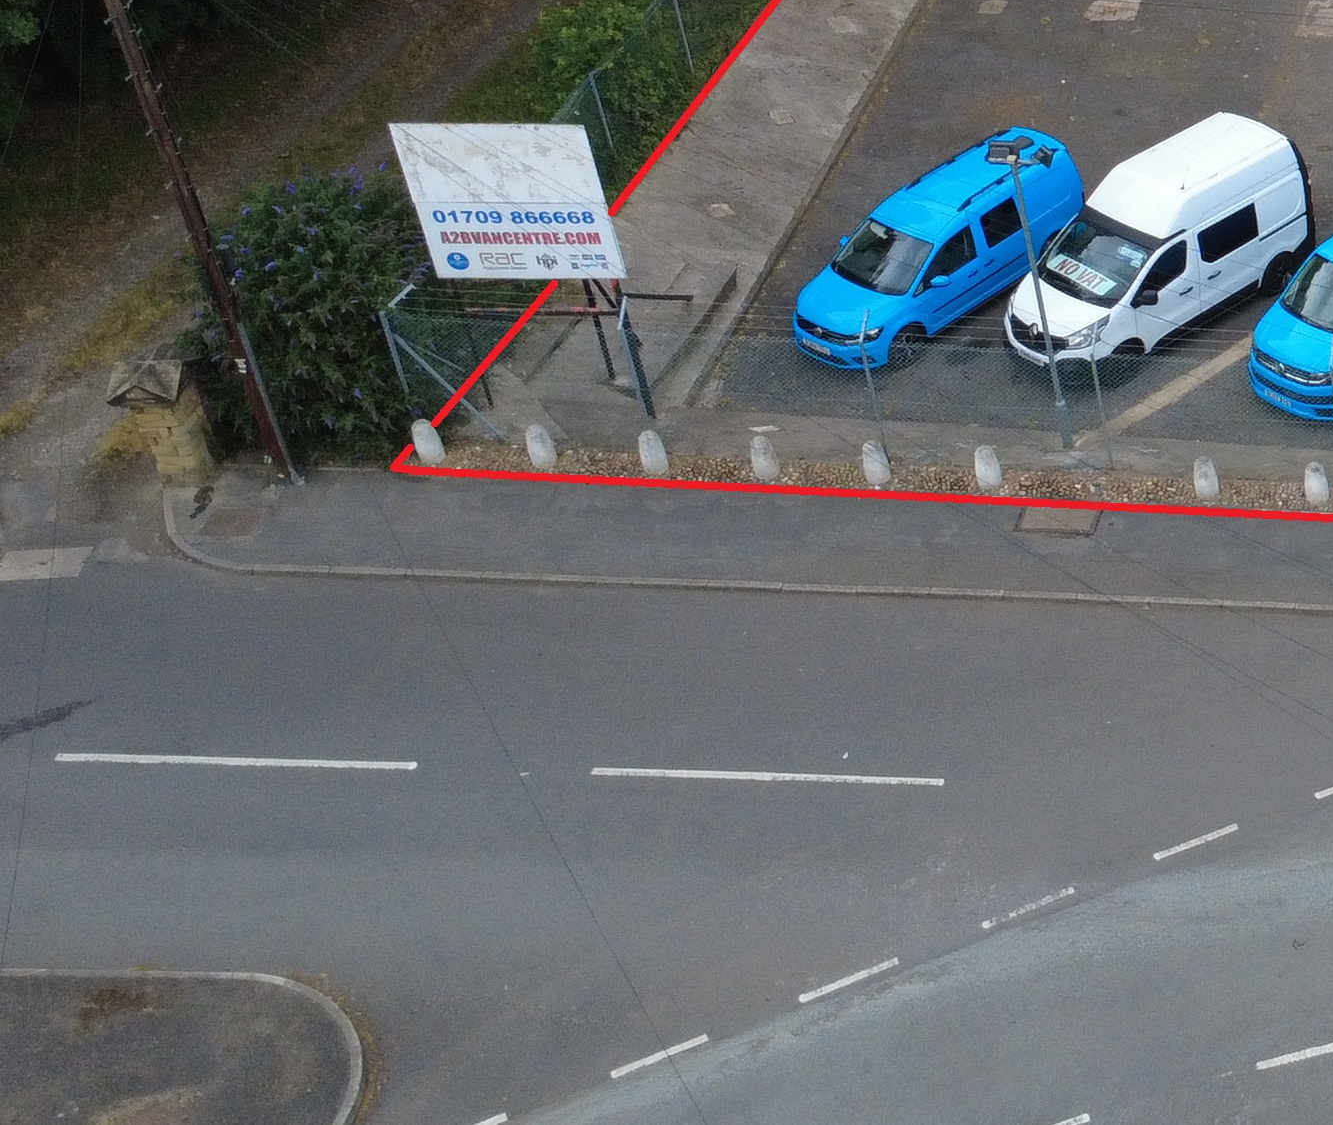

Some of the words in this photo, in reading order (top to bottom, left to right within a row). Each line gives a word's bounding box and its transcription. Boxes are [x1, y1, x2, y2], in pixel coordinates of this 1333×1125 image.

[432, 210, 503, 225] 01709
[510, 210, 595, 225] 866668
[440, 231, 602, 245] A2BVANCENTRE.COM
[1054, 258, 1081, 275] NO
[1075, 269, 1108, 289] VAT
